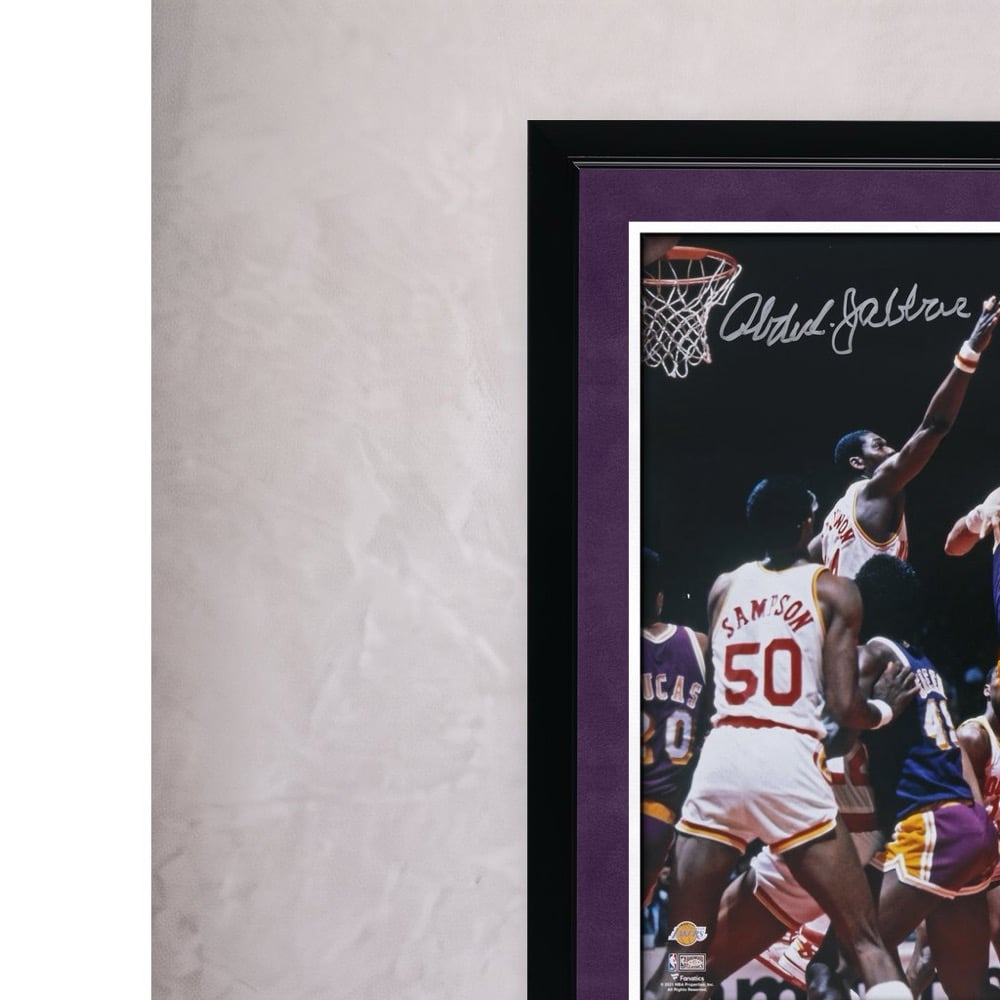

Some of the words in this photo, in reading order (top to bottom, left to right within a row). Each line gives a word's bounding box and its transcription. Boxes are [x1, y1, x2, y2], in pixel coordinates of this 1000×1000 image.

[721, 594, 814, 638] SAMPSON
[723, 638, 803, 707] 50
[680, 974, 705, 982] Fanatics
